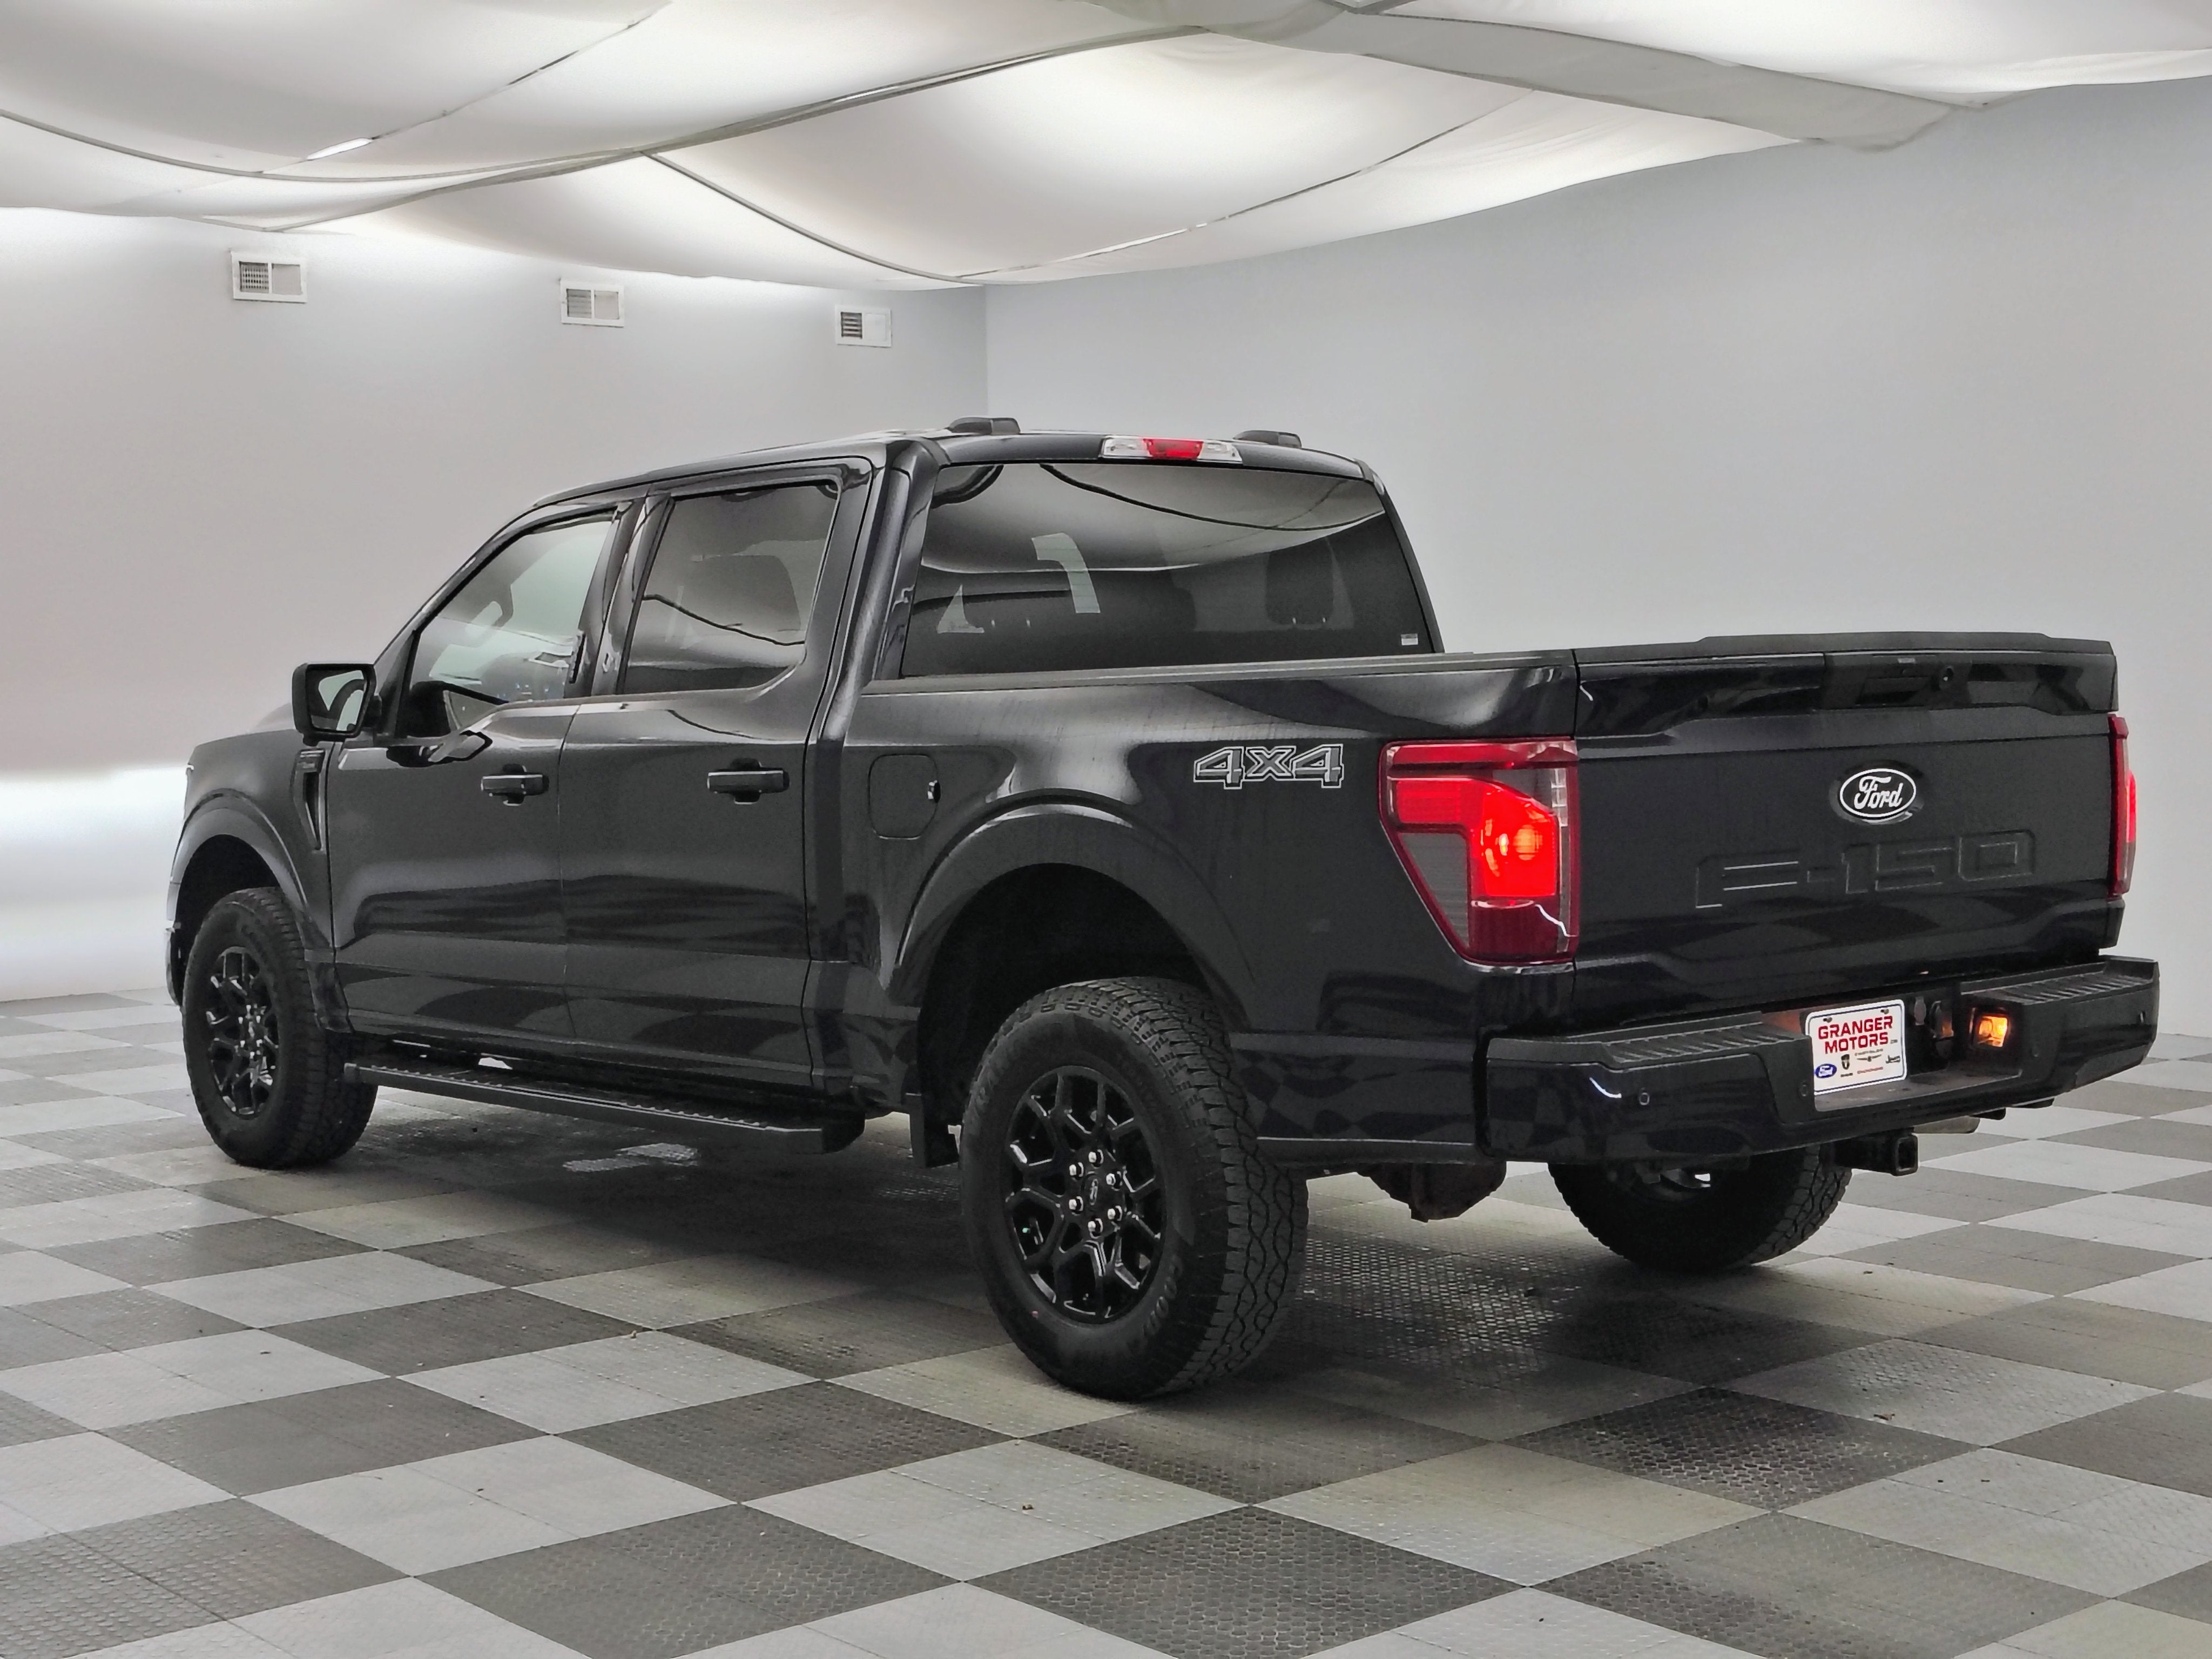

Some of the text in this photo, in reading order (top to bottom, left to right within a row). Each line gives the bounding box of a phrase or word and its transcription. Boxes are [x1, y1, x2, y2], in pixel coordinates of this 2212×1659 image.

[1854, 775, 1904, 809] Ford
[1695, 829, 2036, 909] F-150
[1818, 1016, 1893, 1040] GRANGER
[1825, 1032, 1889, 1054] MOTORS
